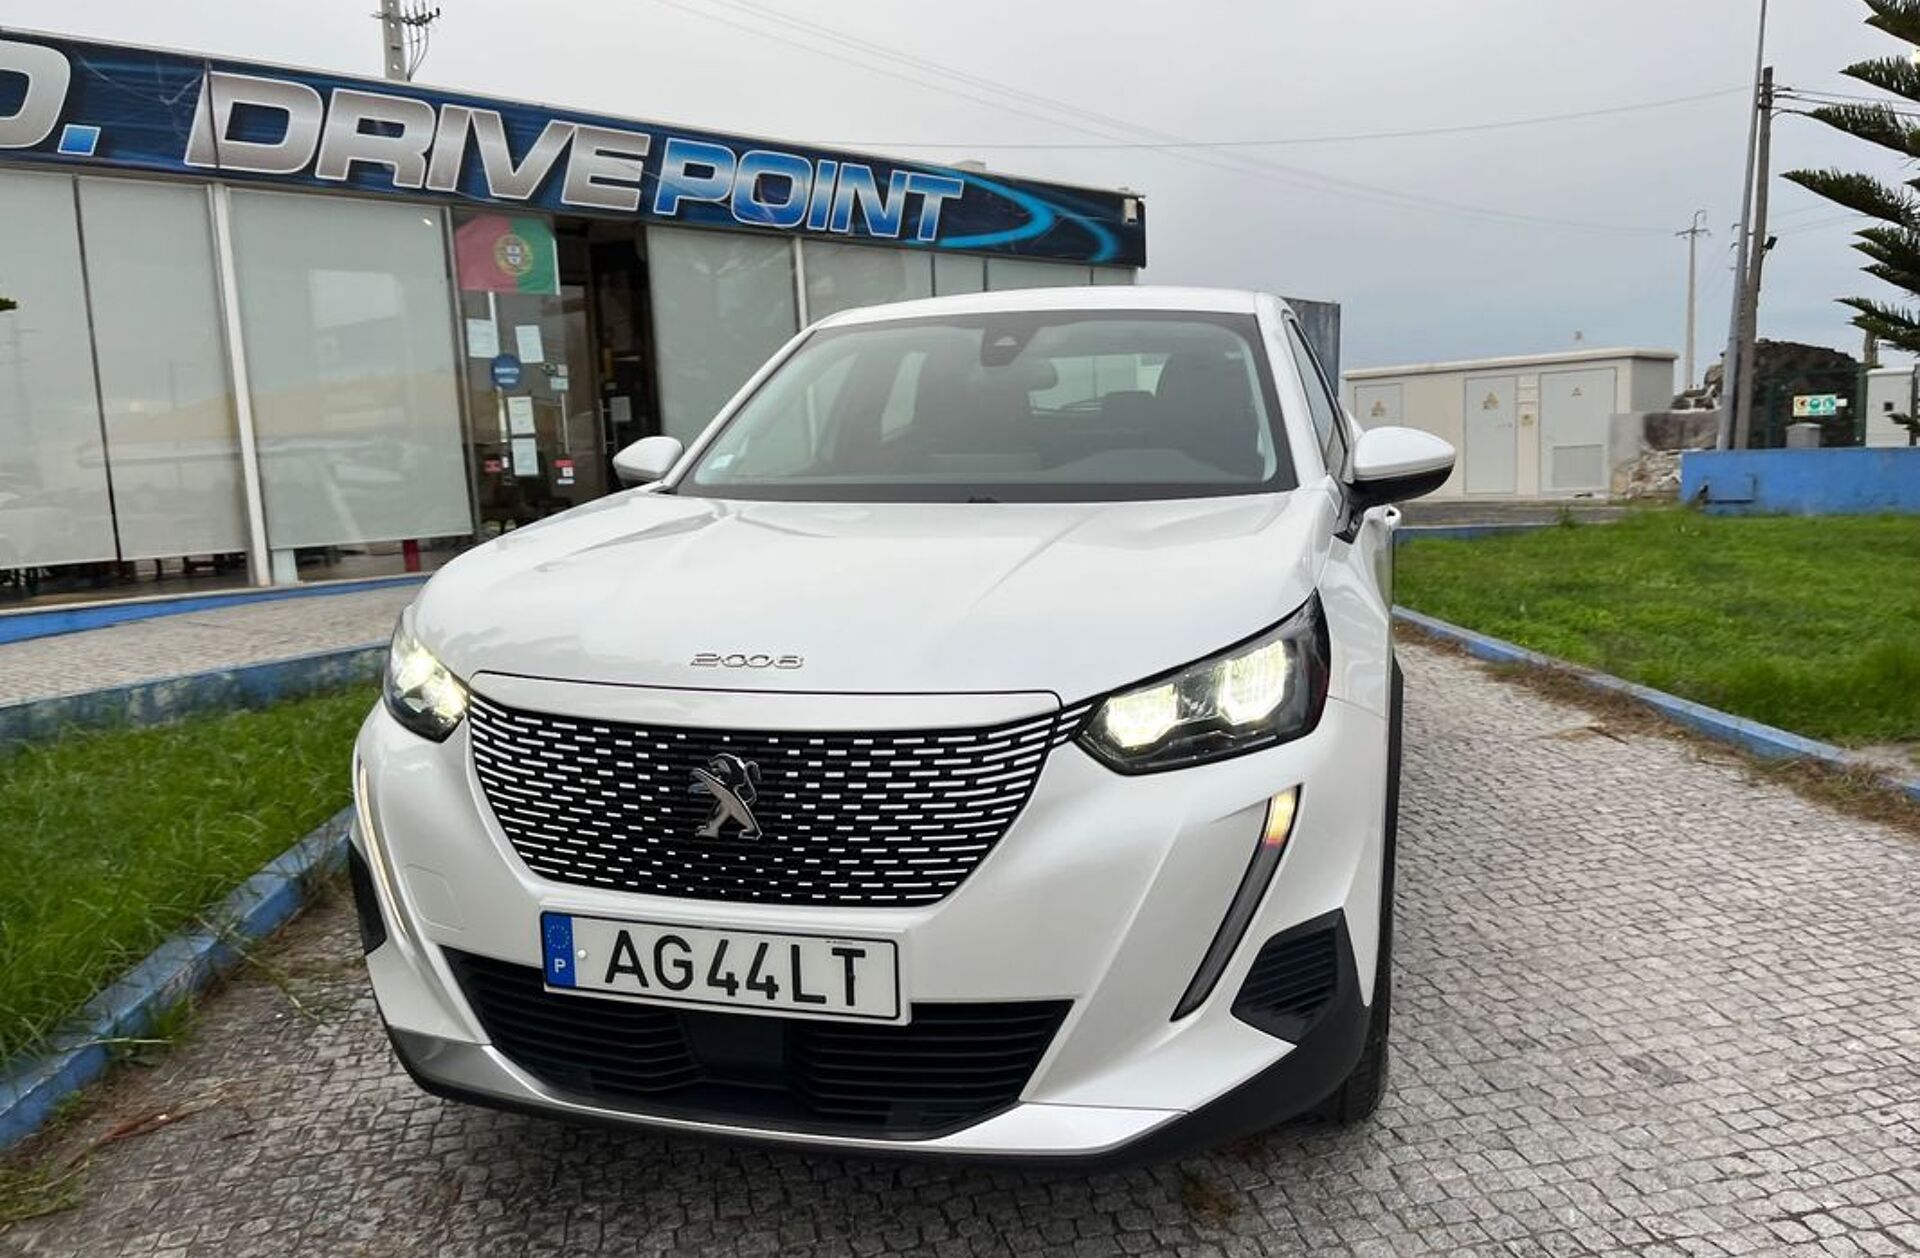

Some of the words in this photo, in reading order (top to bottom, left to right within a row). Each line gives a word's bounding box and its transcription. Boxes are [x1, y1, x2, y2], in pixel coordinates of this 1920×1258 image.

[184, 71, 651, 211] DRIVE
[653, 137, 964, 242] POINT
[690, 652, 805, 670] 2008
[554, 958, 567, 973] P
